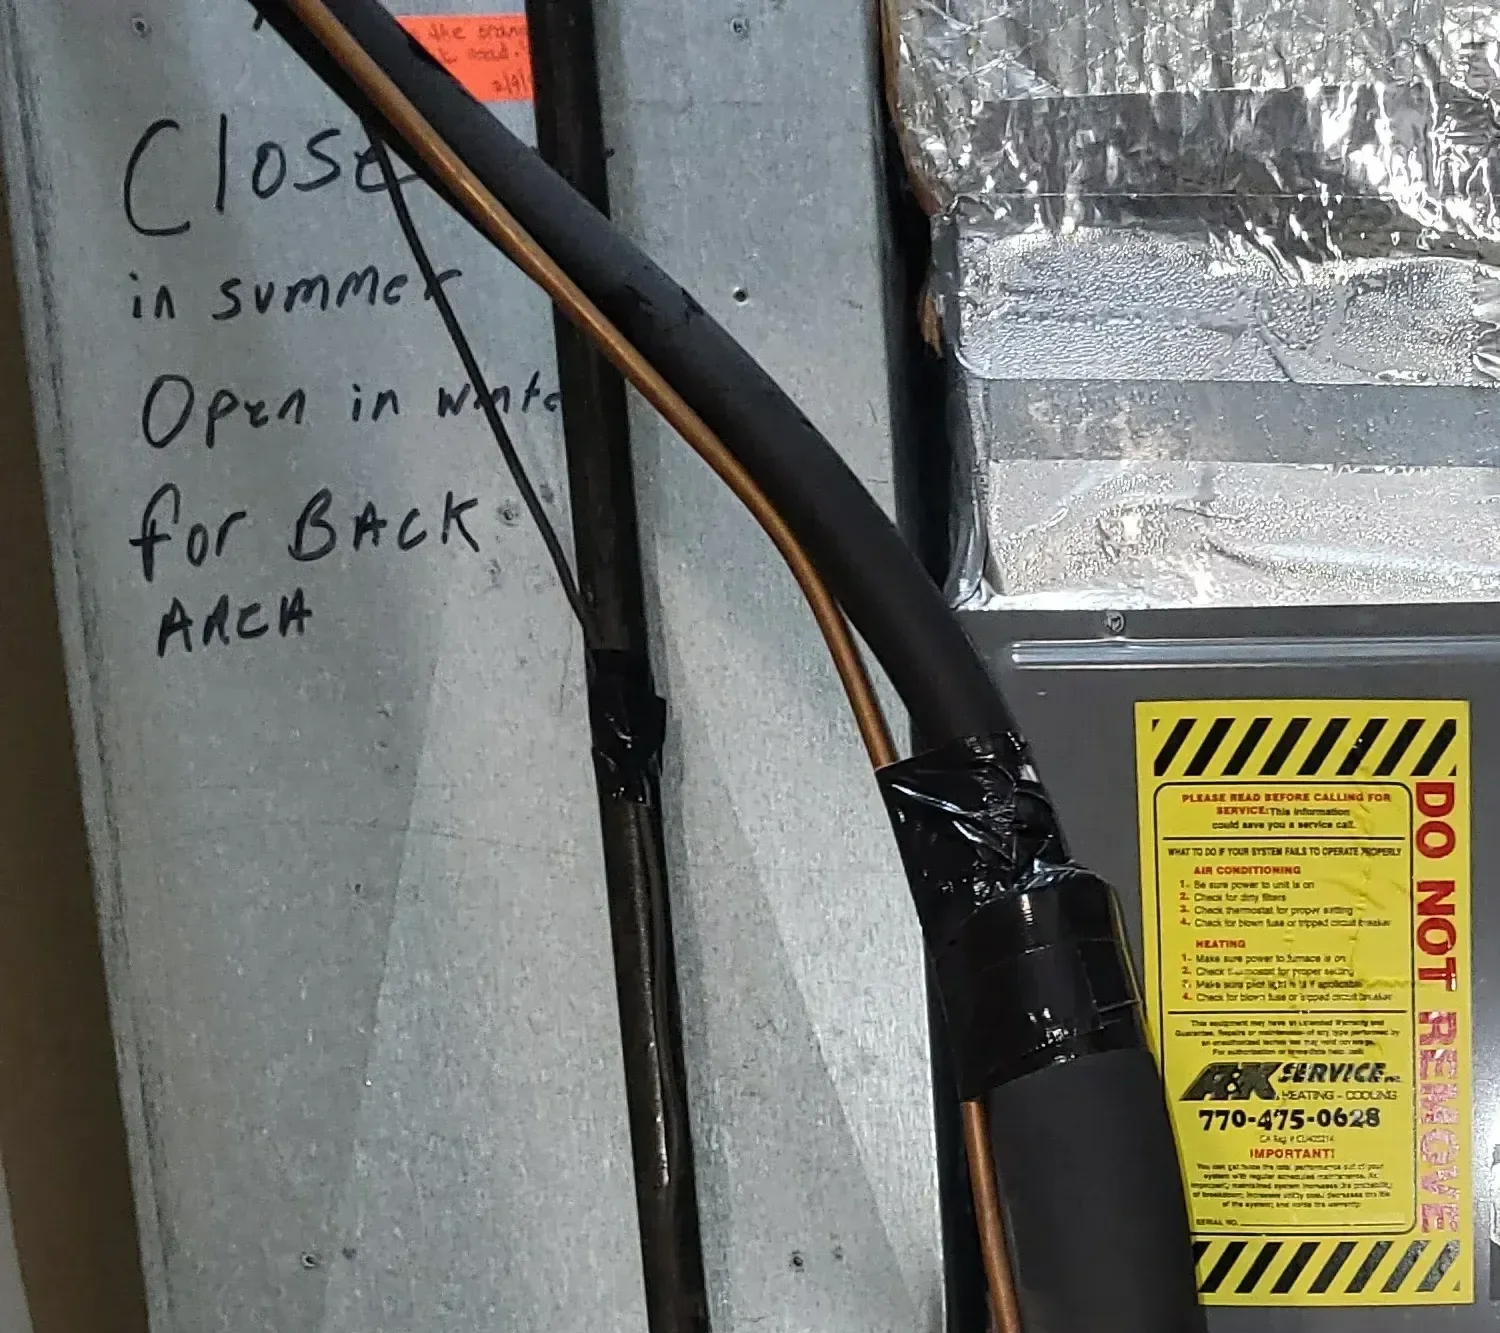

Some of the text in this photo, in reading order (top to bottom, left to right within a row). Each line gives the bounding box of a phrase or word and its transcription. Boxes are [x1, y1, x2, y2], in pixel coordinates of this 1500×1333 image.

[124, 114, 425, 236] Close
[131, 266, 464, 322] in summer
[142, 371, 563, 449] Open in wnte
[128, 484, 480, 581] for BACK
[1182, 793, 1391, 802] PLEASE READ BEFORE CALLING FOR
[1270, 808, 1290, 816] This
[1294, 808, 1350, 816] information
[1212, 821, 1239, 829] could
[1268, 822, 1286, 831] you
[1168, 848, 1190, 856] WHAT
[1192, 848, 1202, 856] TO
[1205, 848, 1216, 856] DO
[1219, 848, 1224, 856] IF
[1228, 848, 1249, 856] YOUR
[1252, 847, 1282, 856] SYSTEM
[1285, 847, 1306, 856] FAILS
[1310, 847, 1320, 856] TO
[1322, 847, 1358, 856] OPERATE
[1216, 866, 1300, 874] CONDITIONING
[1196, 940, 1246, 948] HEATING
[1416, 782, 1461, 1234] DO NOT REMOVE
[1278, 1063, 1386, 1083] SERVICE
[1282, 1090, 1397, 1100] HEATING COOLING
[1199, 1108, 1379, 1130] 770-475-0628
